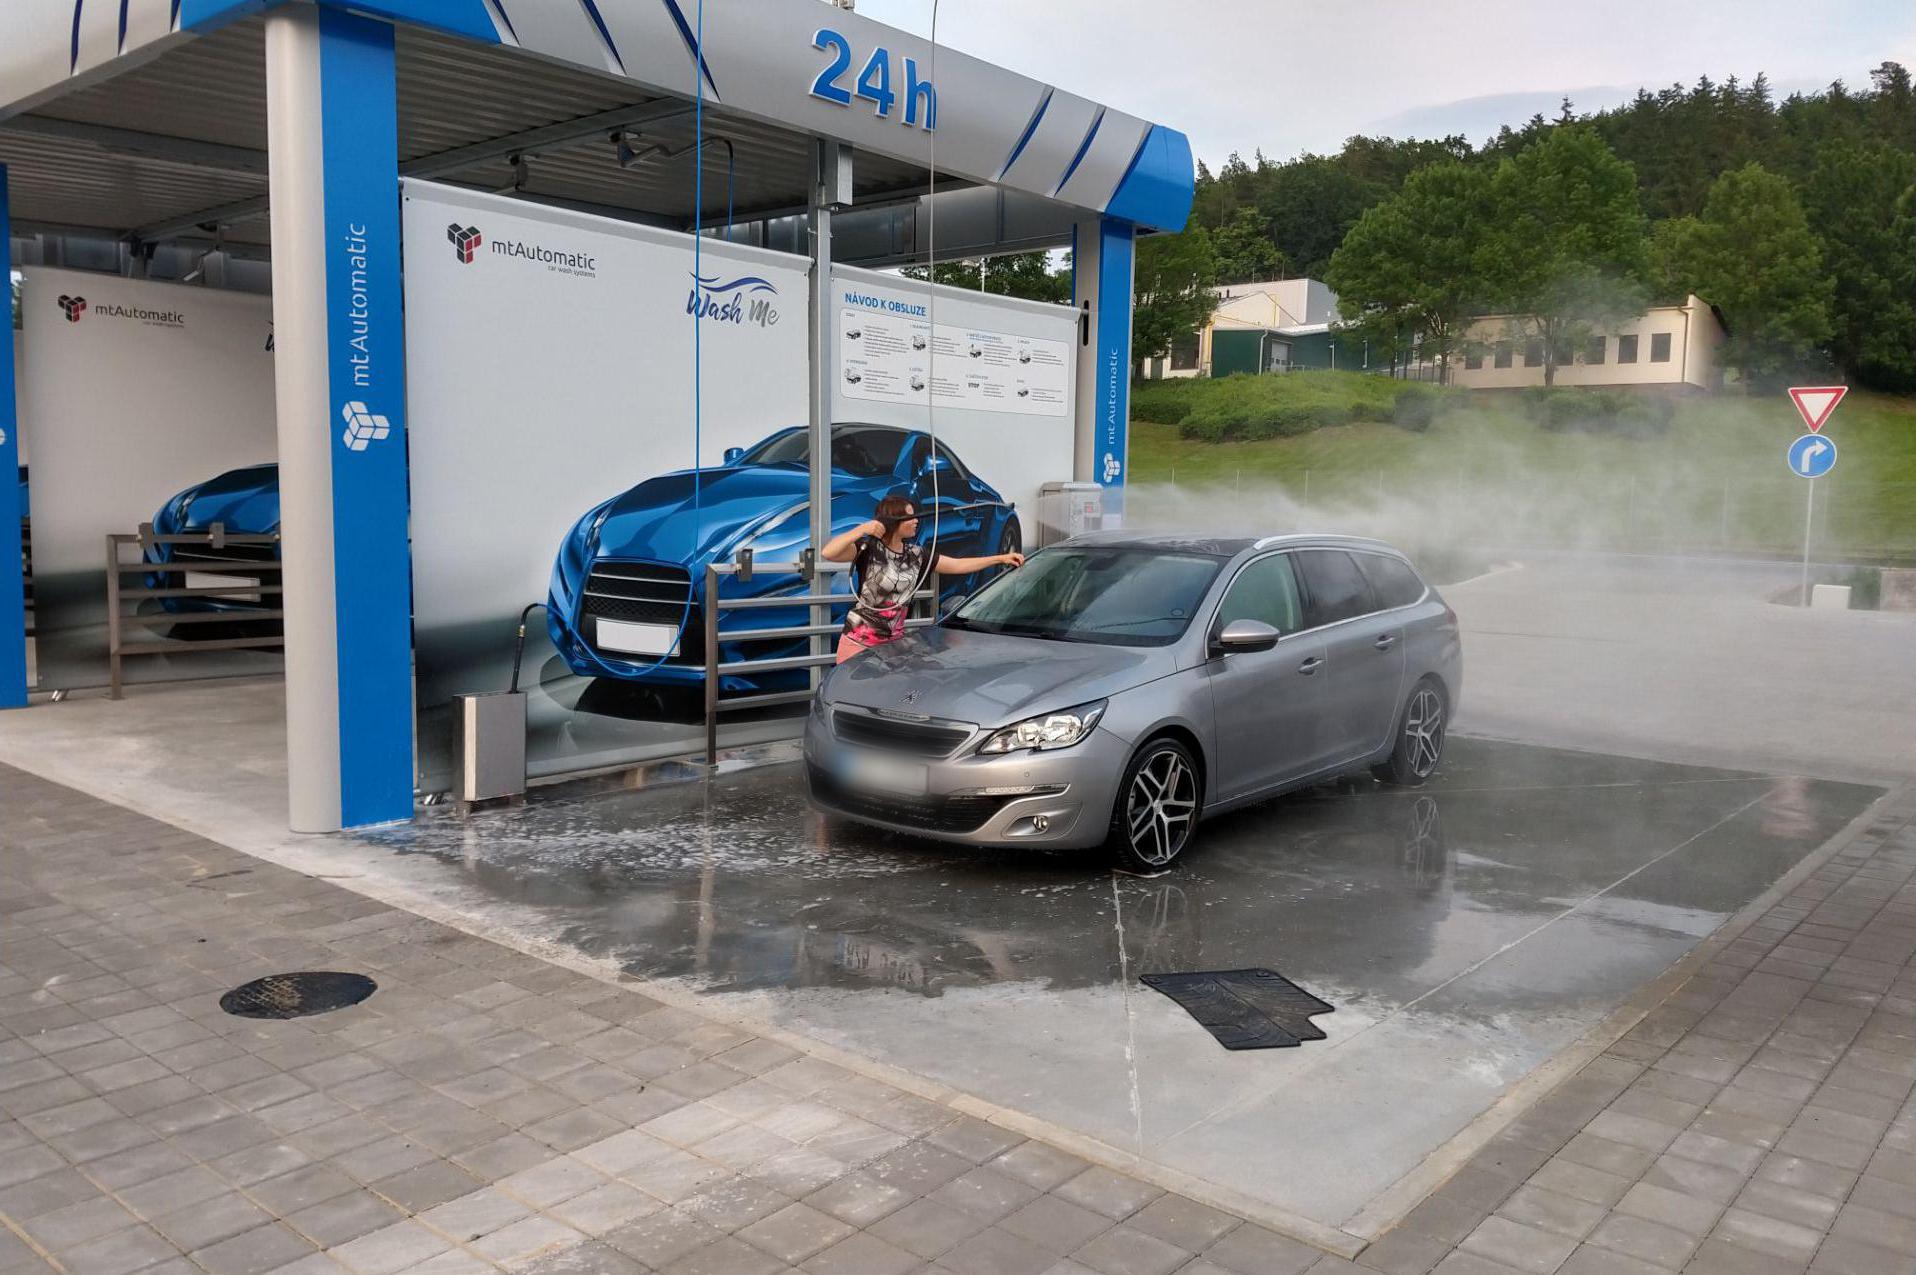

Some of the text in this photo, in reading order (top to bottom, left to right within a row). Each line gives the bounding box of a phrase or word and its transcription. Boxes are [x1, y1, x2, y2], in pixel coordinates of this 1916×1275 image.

[809, 28, 937, 131] 24h
[492, 240, 596, 270] mtAutomatic
[95, 303, 185, 324] mtAutomatic
[345, 223, 370, 386] mtAutomatic
[686, 289, 780, 328] Wash Me
[845, 292, 926, 317] NÁVOD K OBSLUZE
[1108, 347, 1119, 445] mtAutomatic
